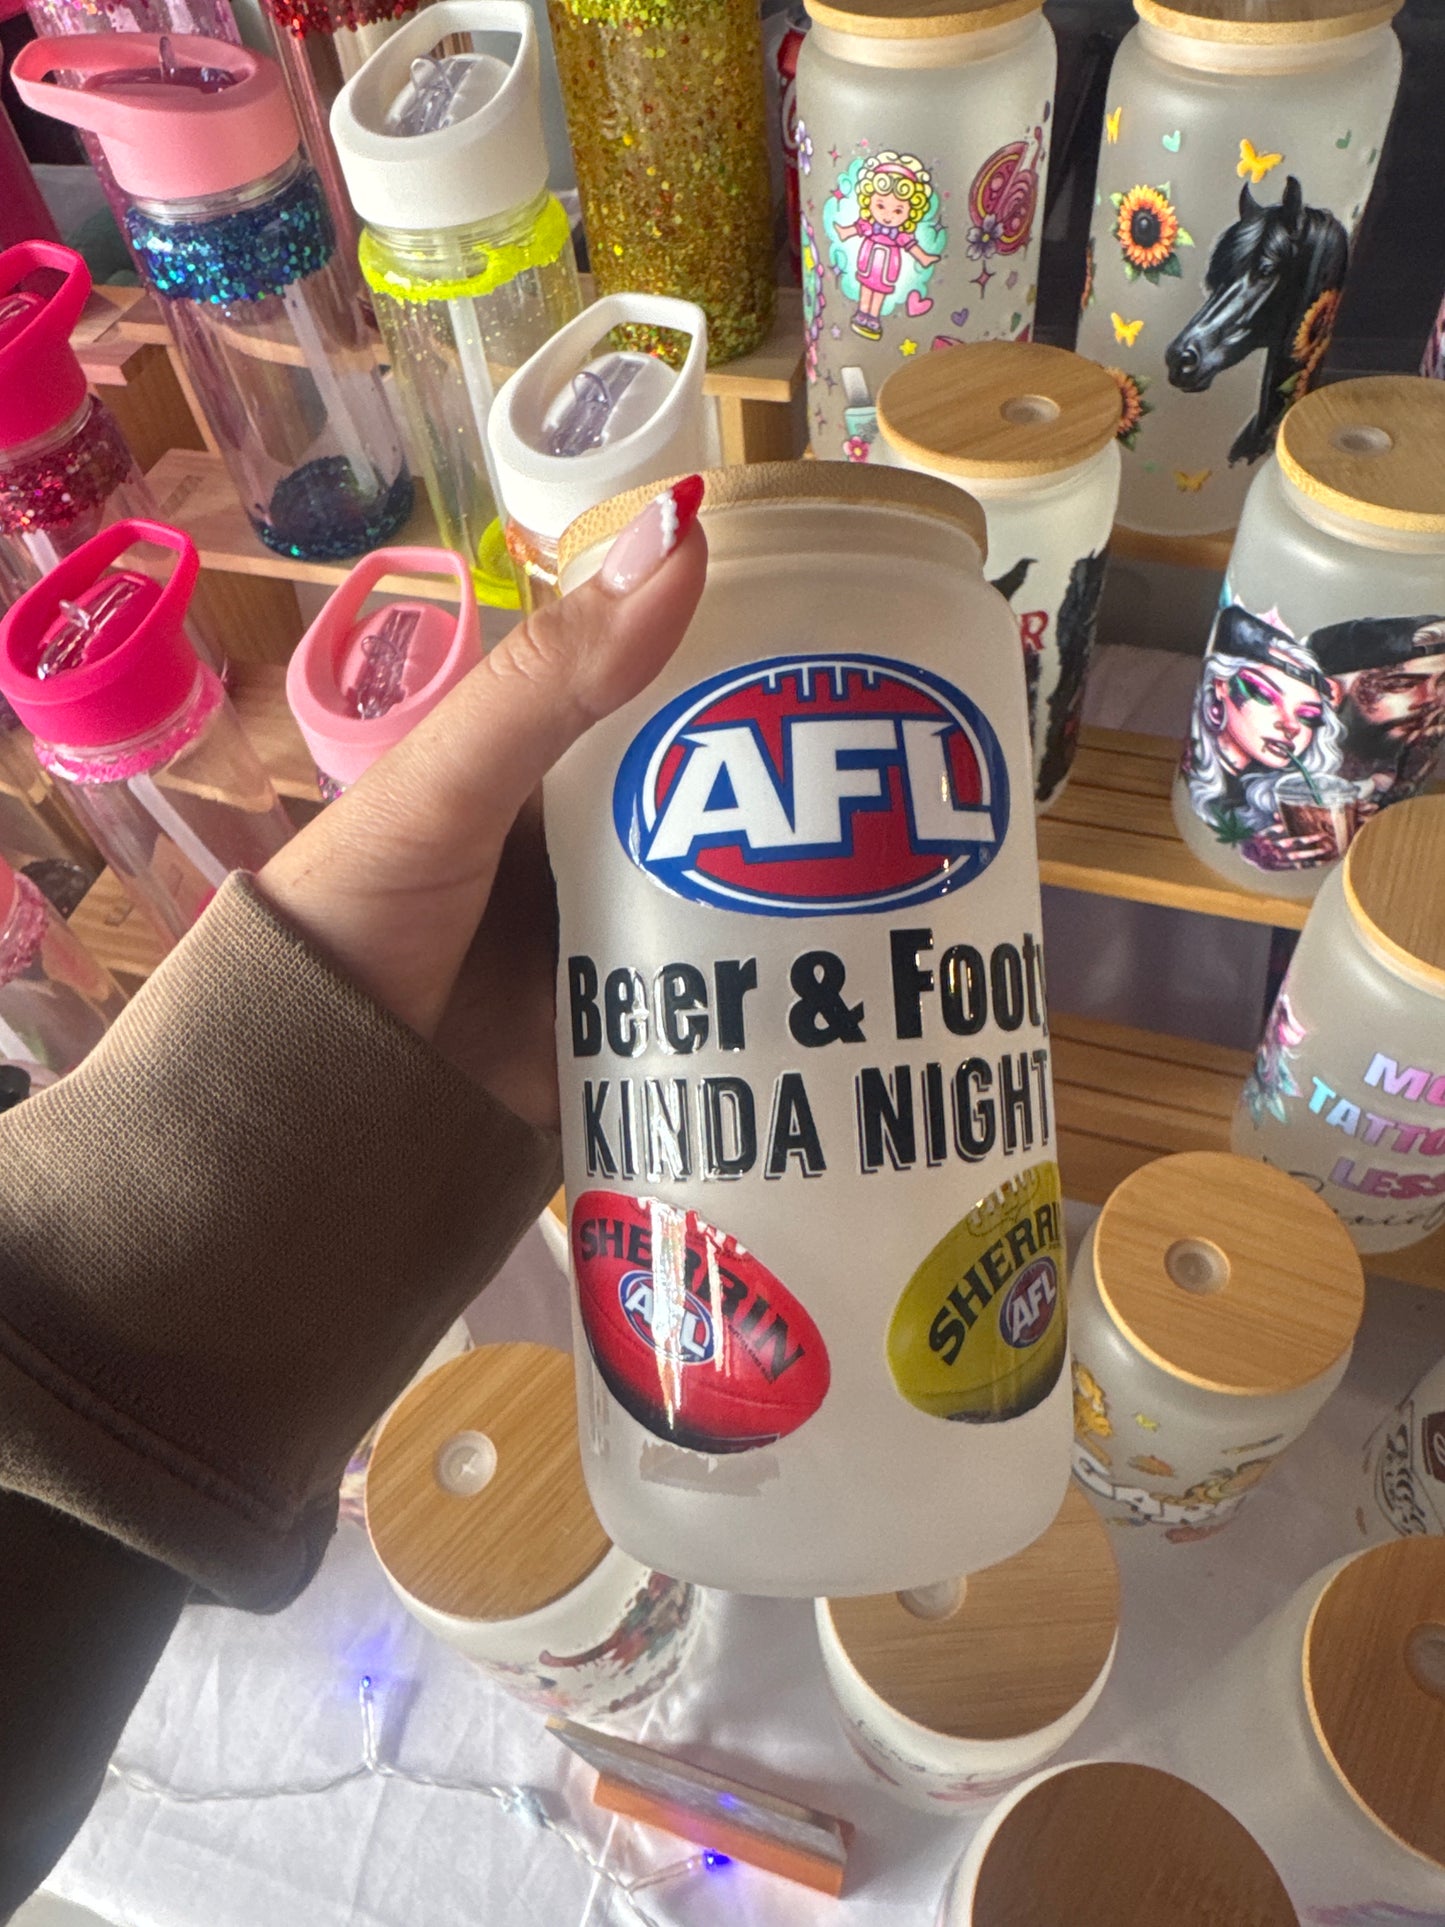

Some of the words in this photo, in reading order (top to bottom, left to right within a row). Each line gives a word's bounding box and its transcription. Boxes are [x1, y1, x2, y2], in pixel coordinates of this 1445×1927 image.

[645, 718, 996, 862] AFL
[568, 955, 758, 1058] Beer
[788, 950, 867, 1048] &
[583, 1071, 827, 1183] KINDA
[854, 1048, 1051, 1175] NIGHT
[1011, 1268, 1056, 1343] AFL
